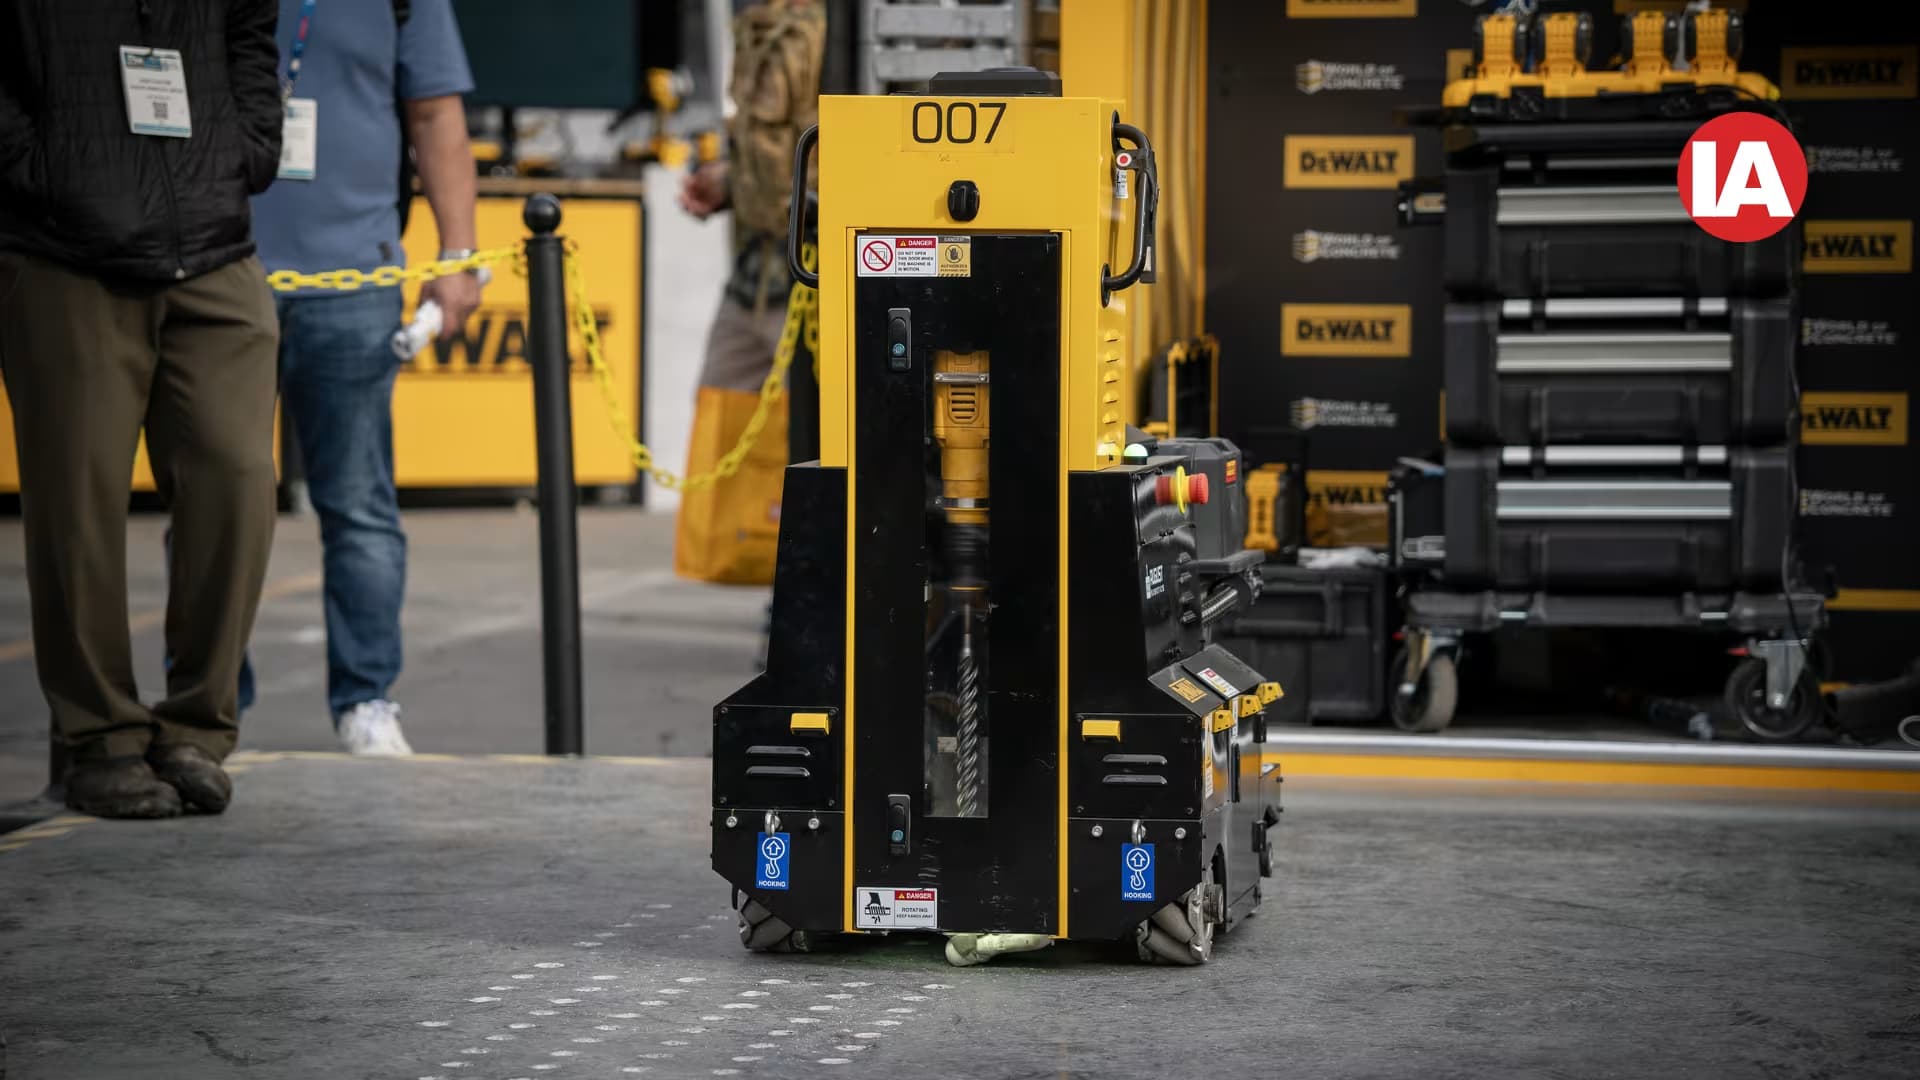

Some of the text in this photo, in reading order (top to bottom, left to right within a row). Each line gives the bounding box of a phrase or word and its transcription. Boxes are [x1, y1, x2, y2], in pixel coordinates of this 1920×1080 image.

[1324, 63, 1376, 76] WORLD
[1323, 77, 1402, 90] CONCRETE
[912, 102, 1007, 144] 007
[1301, 150, 1398, 173] DEWALT
[1801, 233, 1897, 259] EWALT
[1298, 318, 1394, 341] DEWALT
[1801, 406, 1893, 432] EWALT
[758, 880, 786, 888] HOOKING
